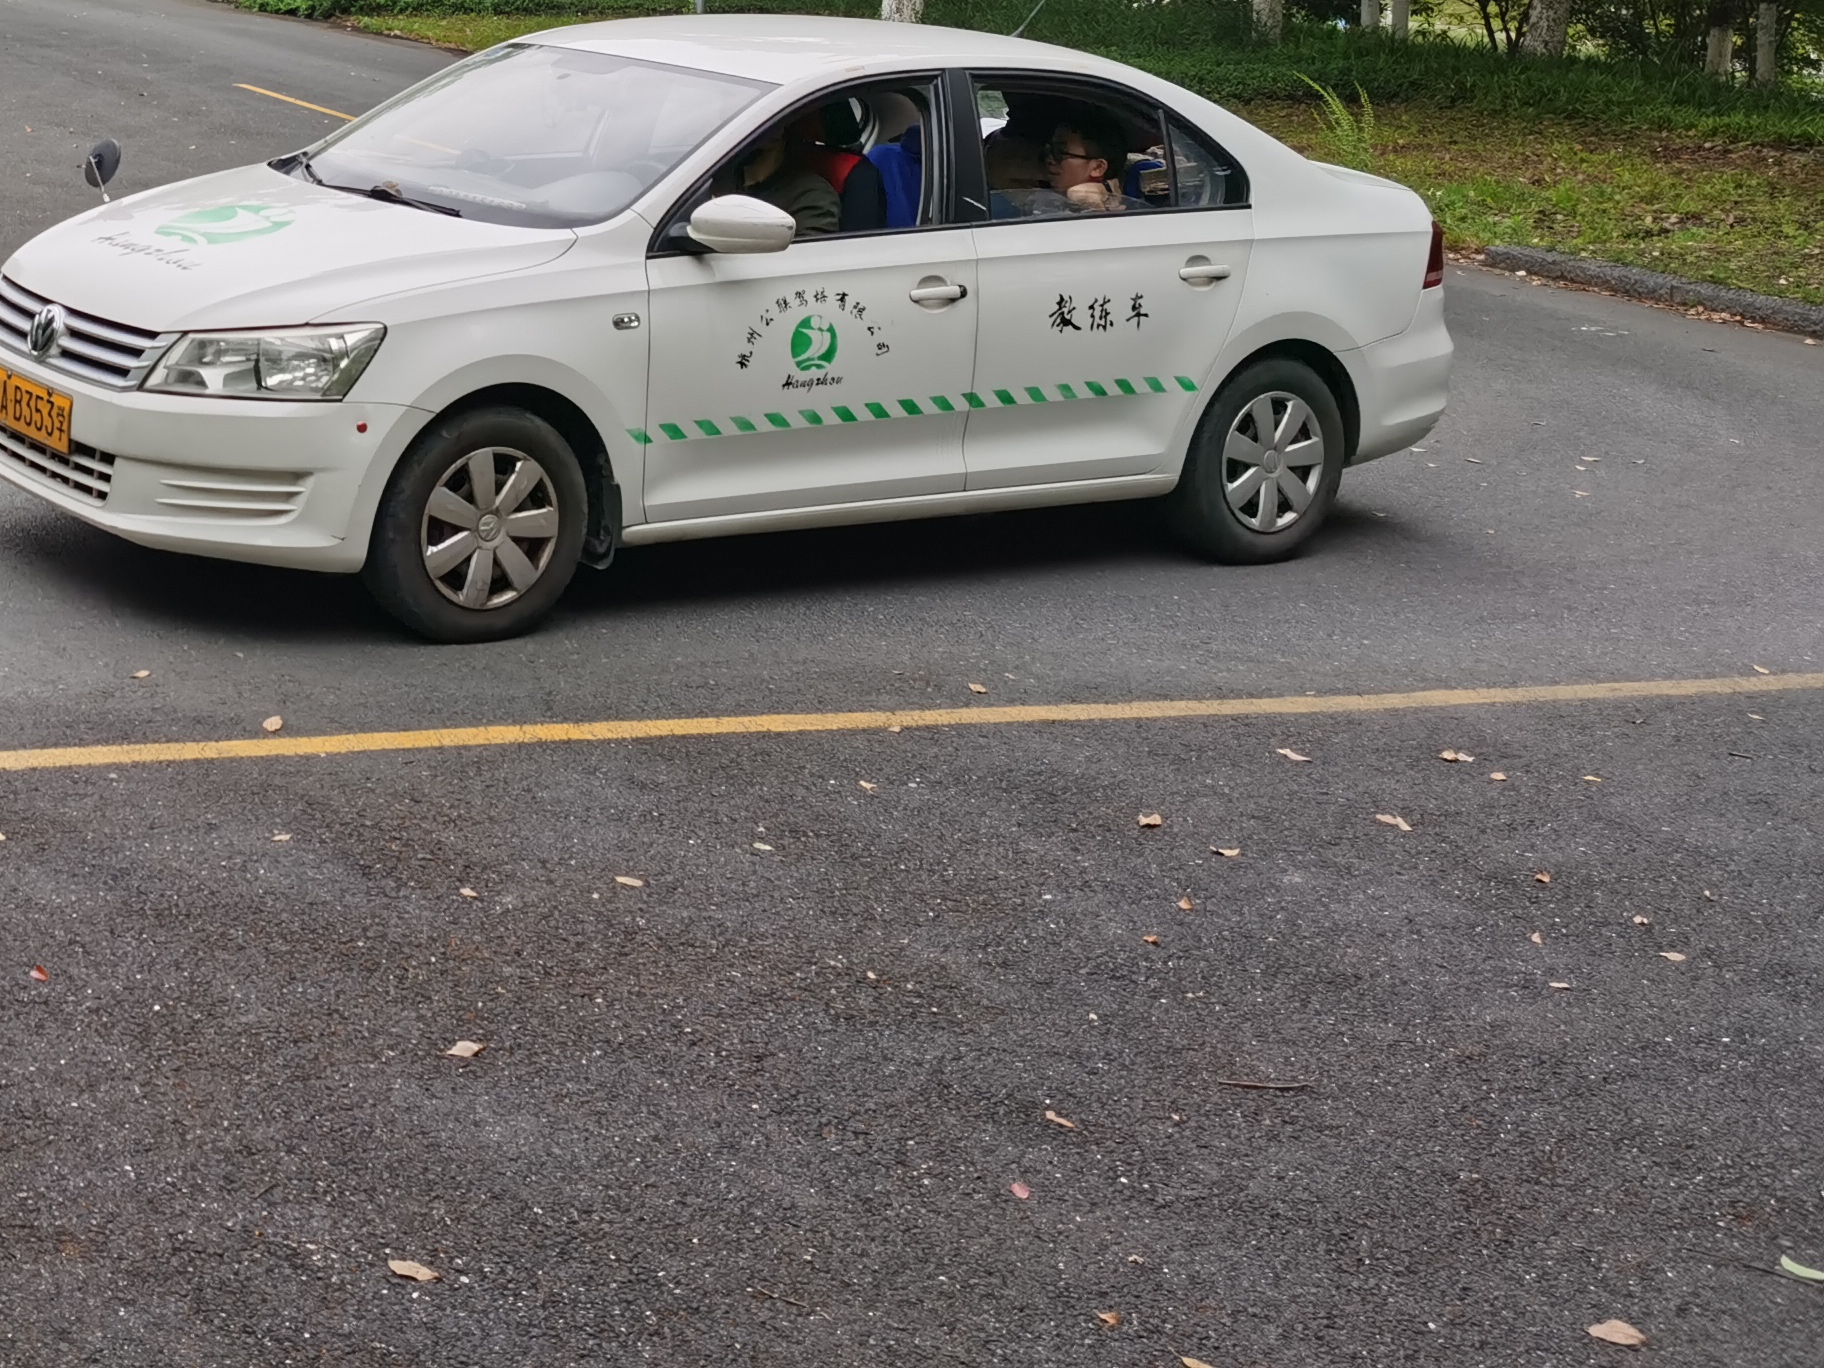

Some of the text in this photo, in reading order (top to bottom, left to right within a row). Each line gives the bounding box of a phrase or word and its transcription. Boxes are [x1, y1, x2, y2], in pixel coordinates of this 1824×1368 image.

[1048, 291, 1150, 334] 教练车
[781, 371, 845, 393] Hangzhou
